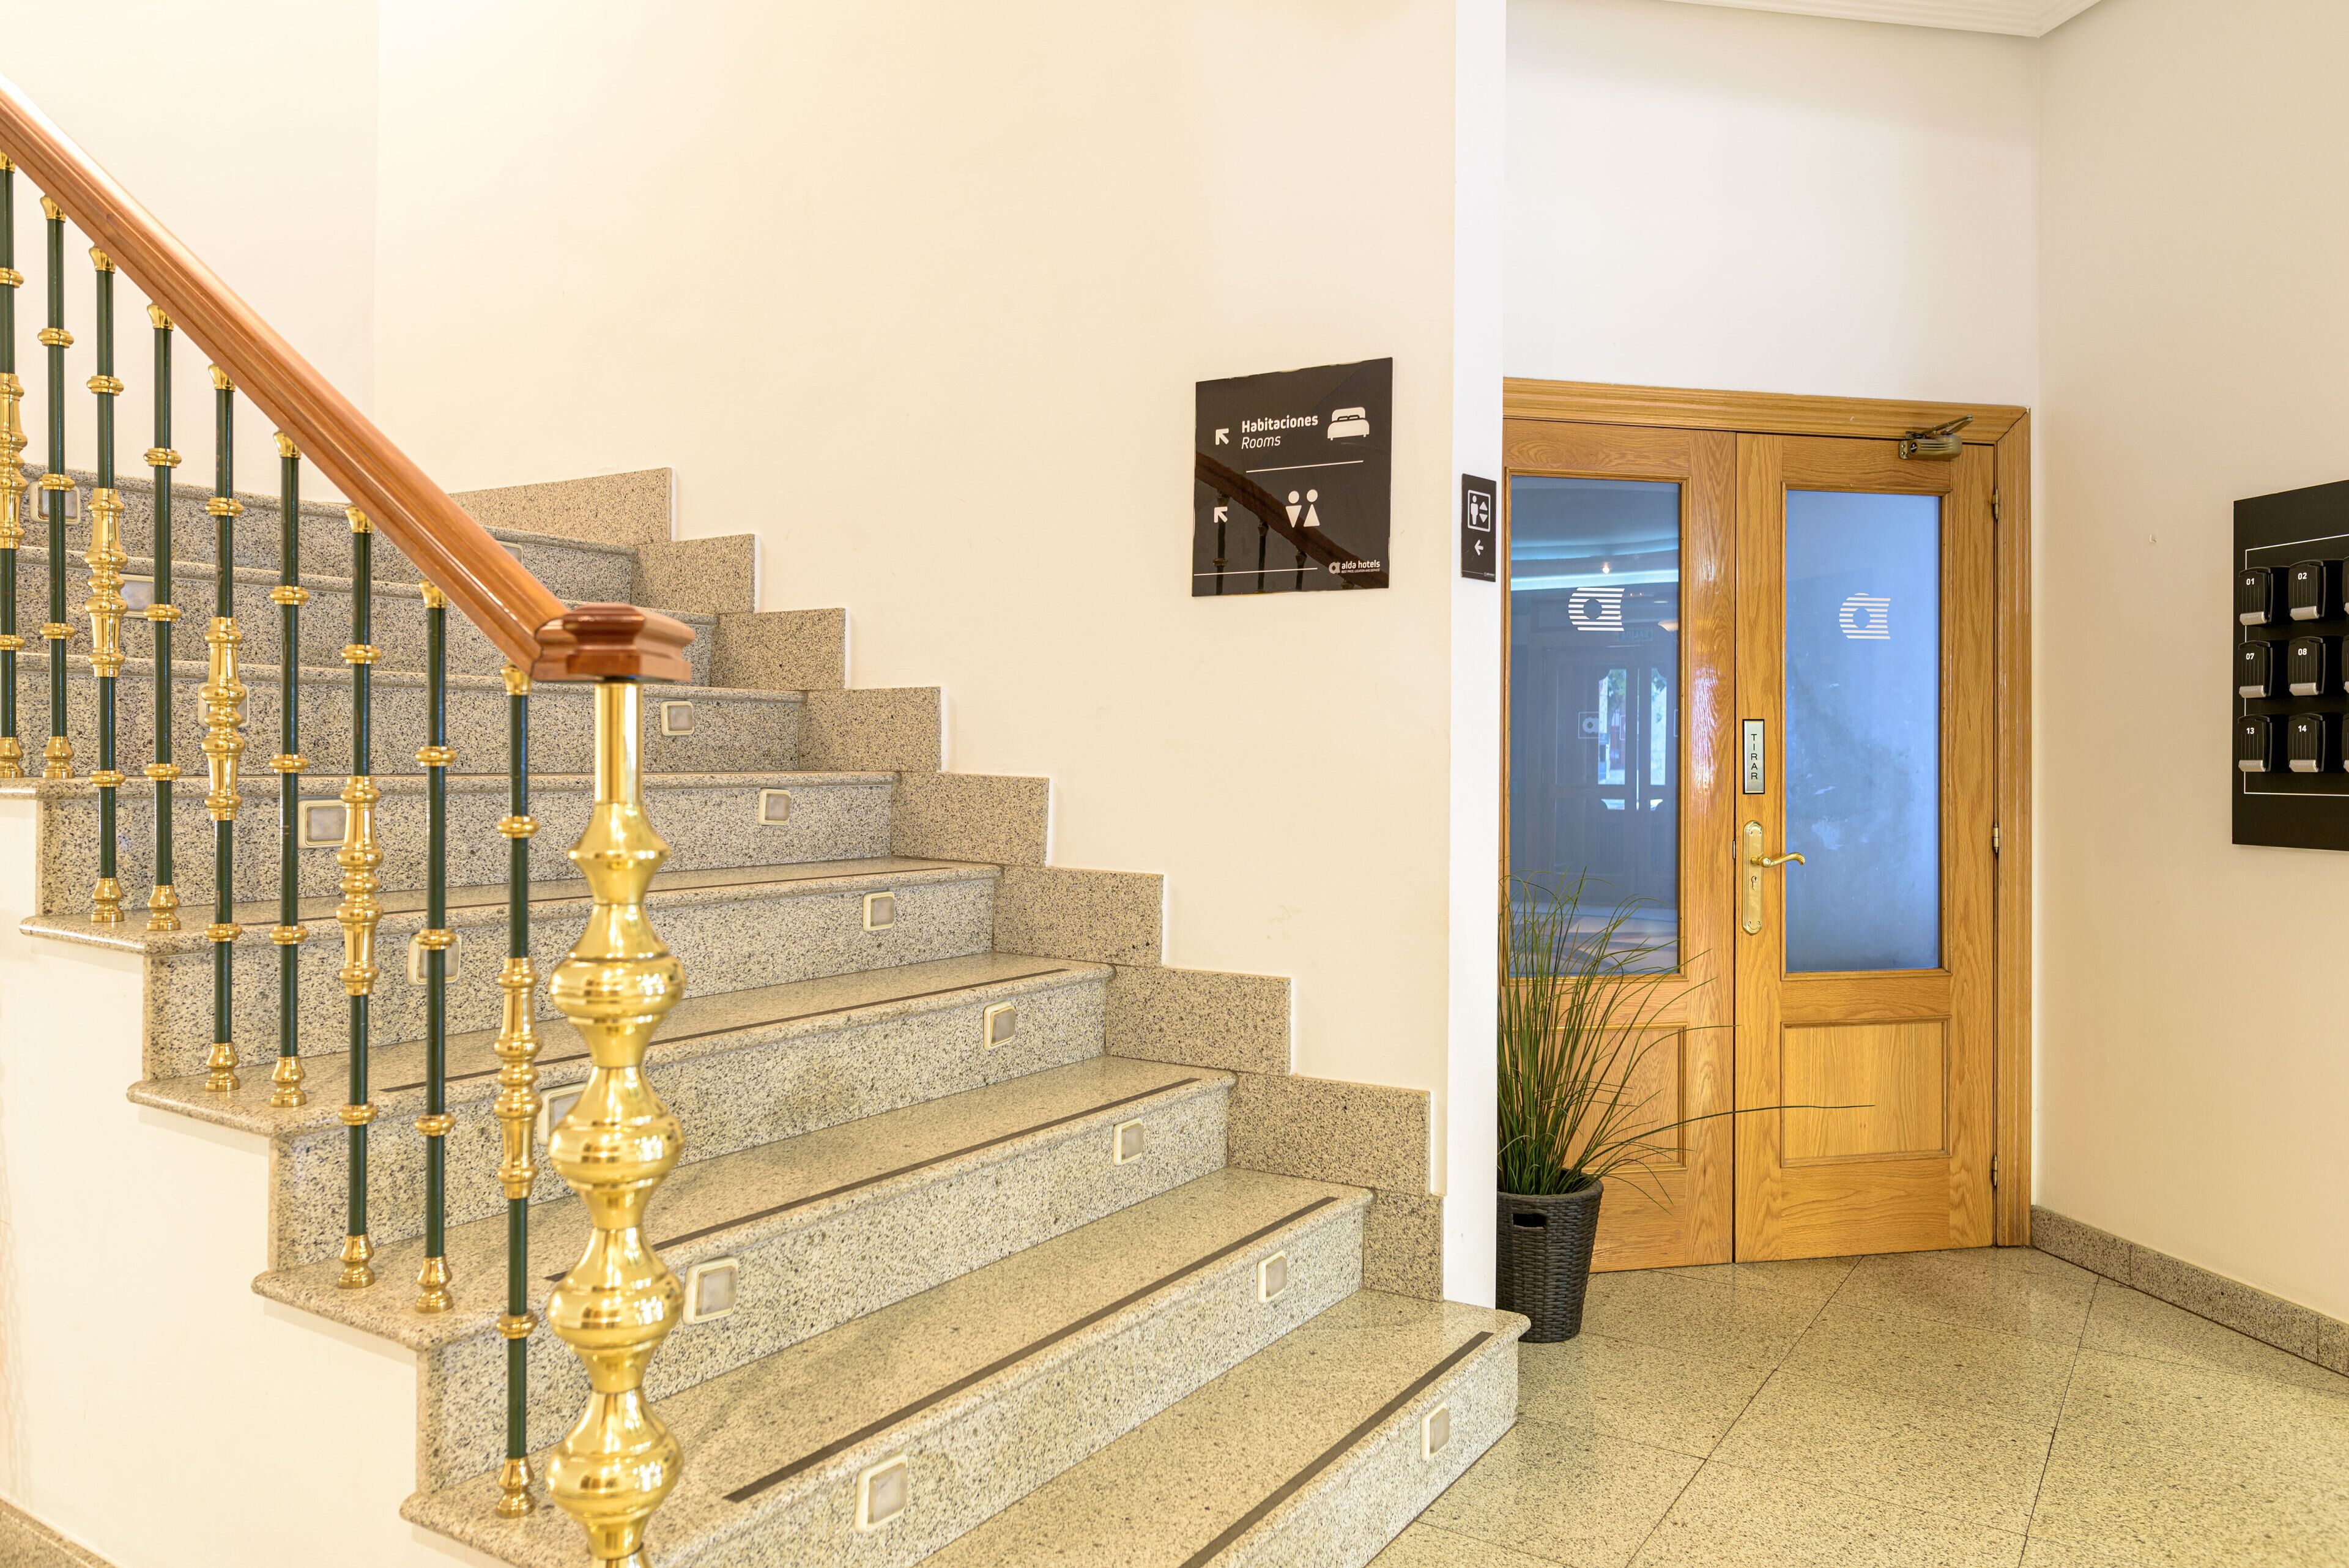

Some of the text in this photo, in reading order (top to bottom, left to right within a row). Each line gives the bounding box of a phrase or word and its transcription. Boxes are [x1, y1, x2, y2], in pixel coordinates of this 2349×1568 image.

[1241, 414, 1318, 433] Habitaciones
[1241, 436, 1281, 450] Rooms
[1341, 559, 1380, 570] alda hotels
[2298, 572, 2307, 581] 02
[2298, 724, 2307, 733] 14
